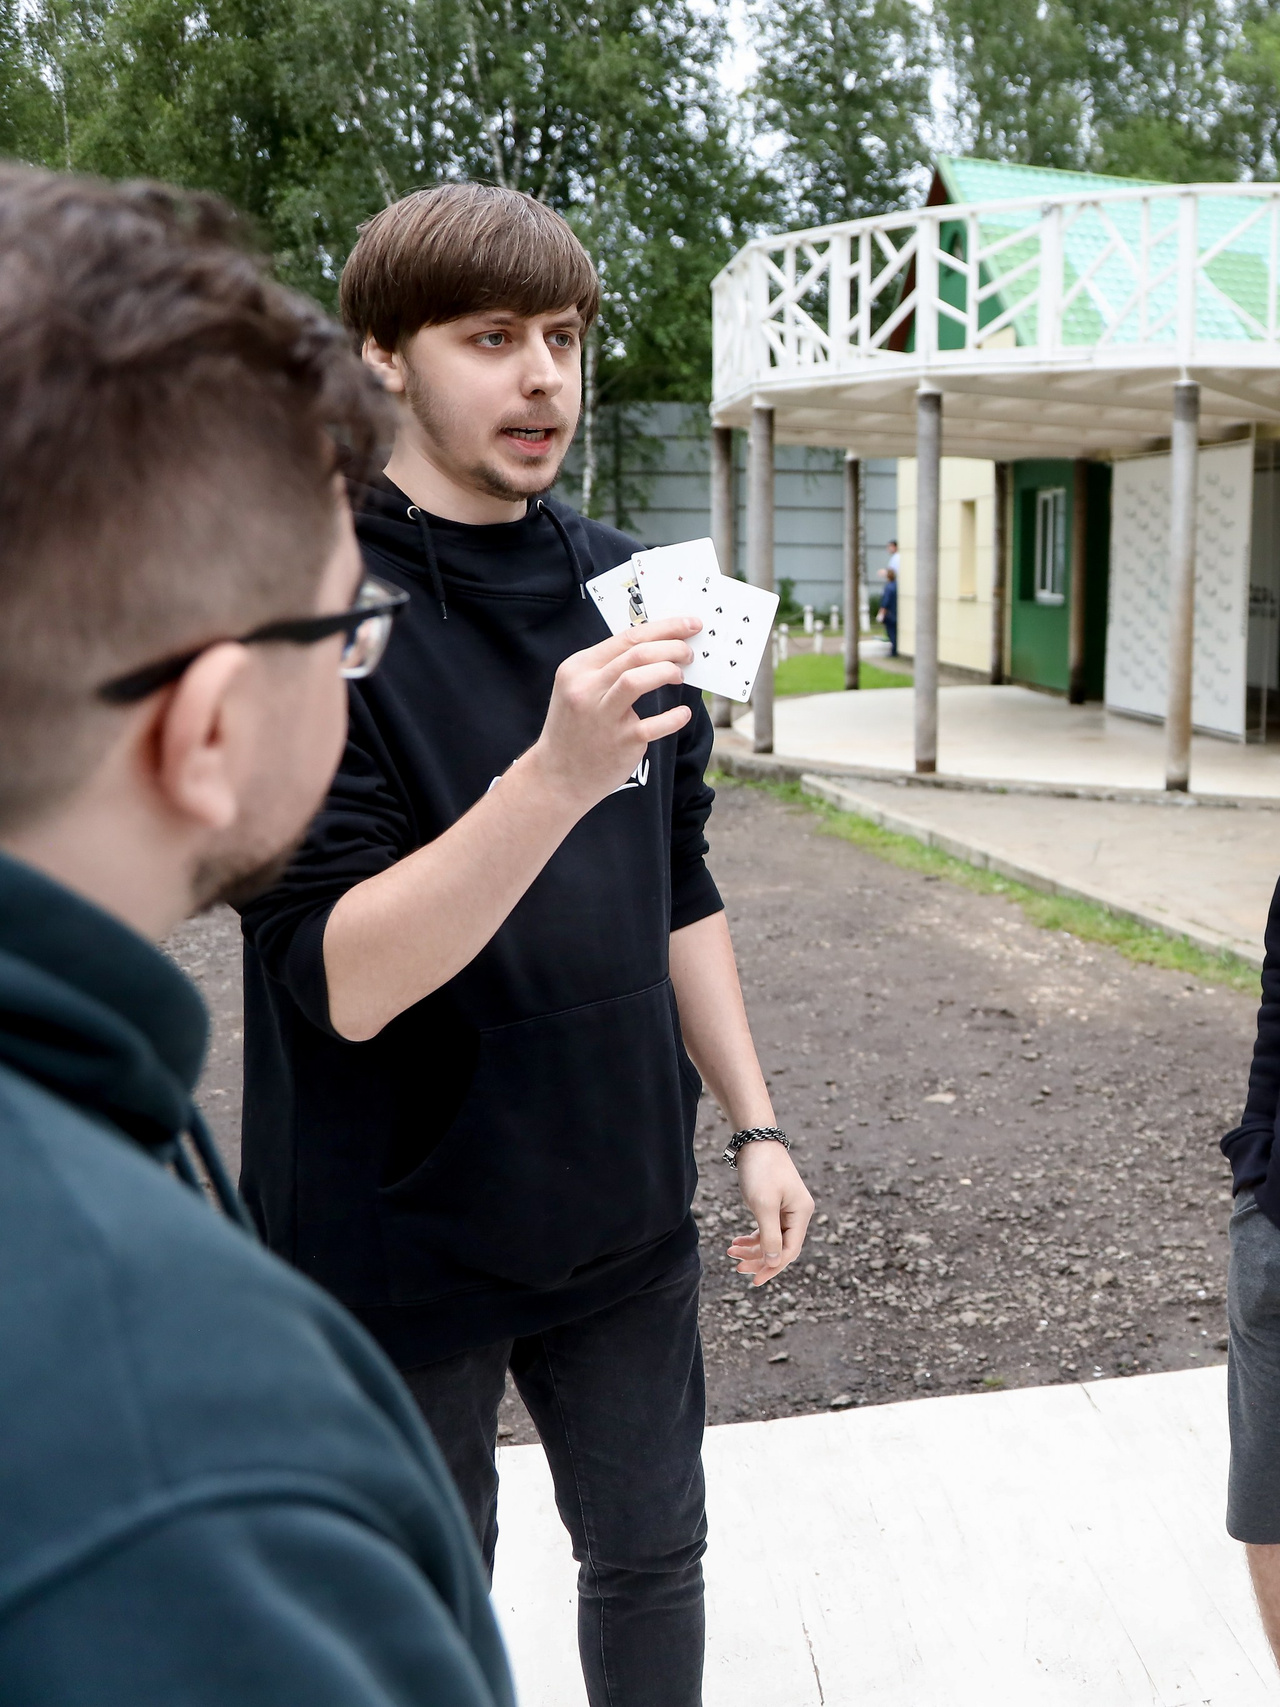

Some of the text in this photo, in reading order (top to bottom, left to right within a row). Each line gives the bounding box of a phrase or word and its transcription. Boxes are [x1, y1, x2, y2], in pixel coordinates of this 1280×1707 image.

[637, 559, 643, 567] 2
[704, 577, 711, 585] 6
[592, 586, 599, 594] K
